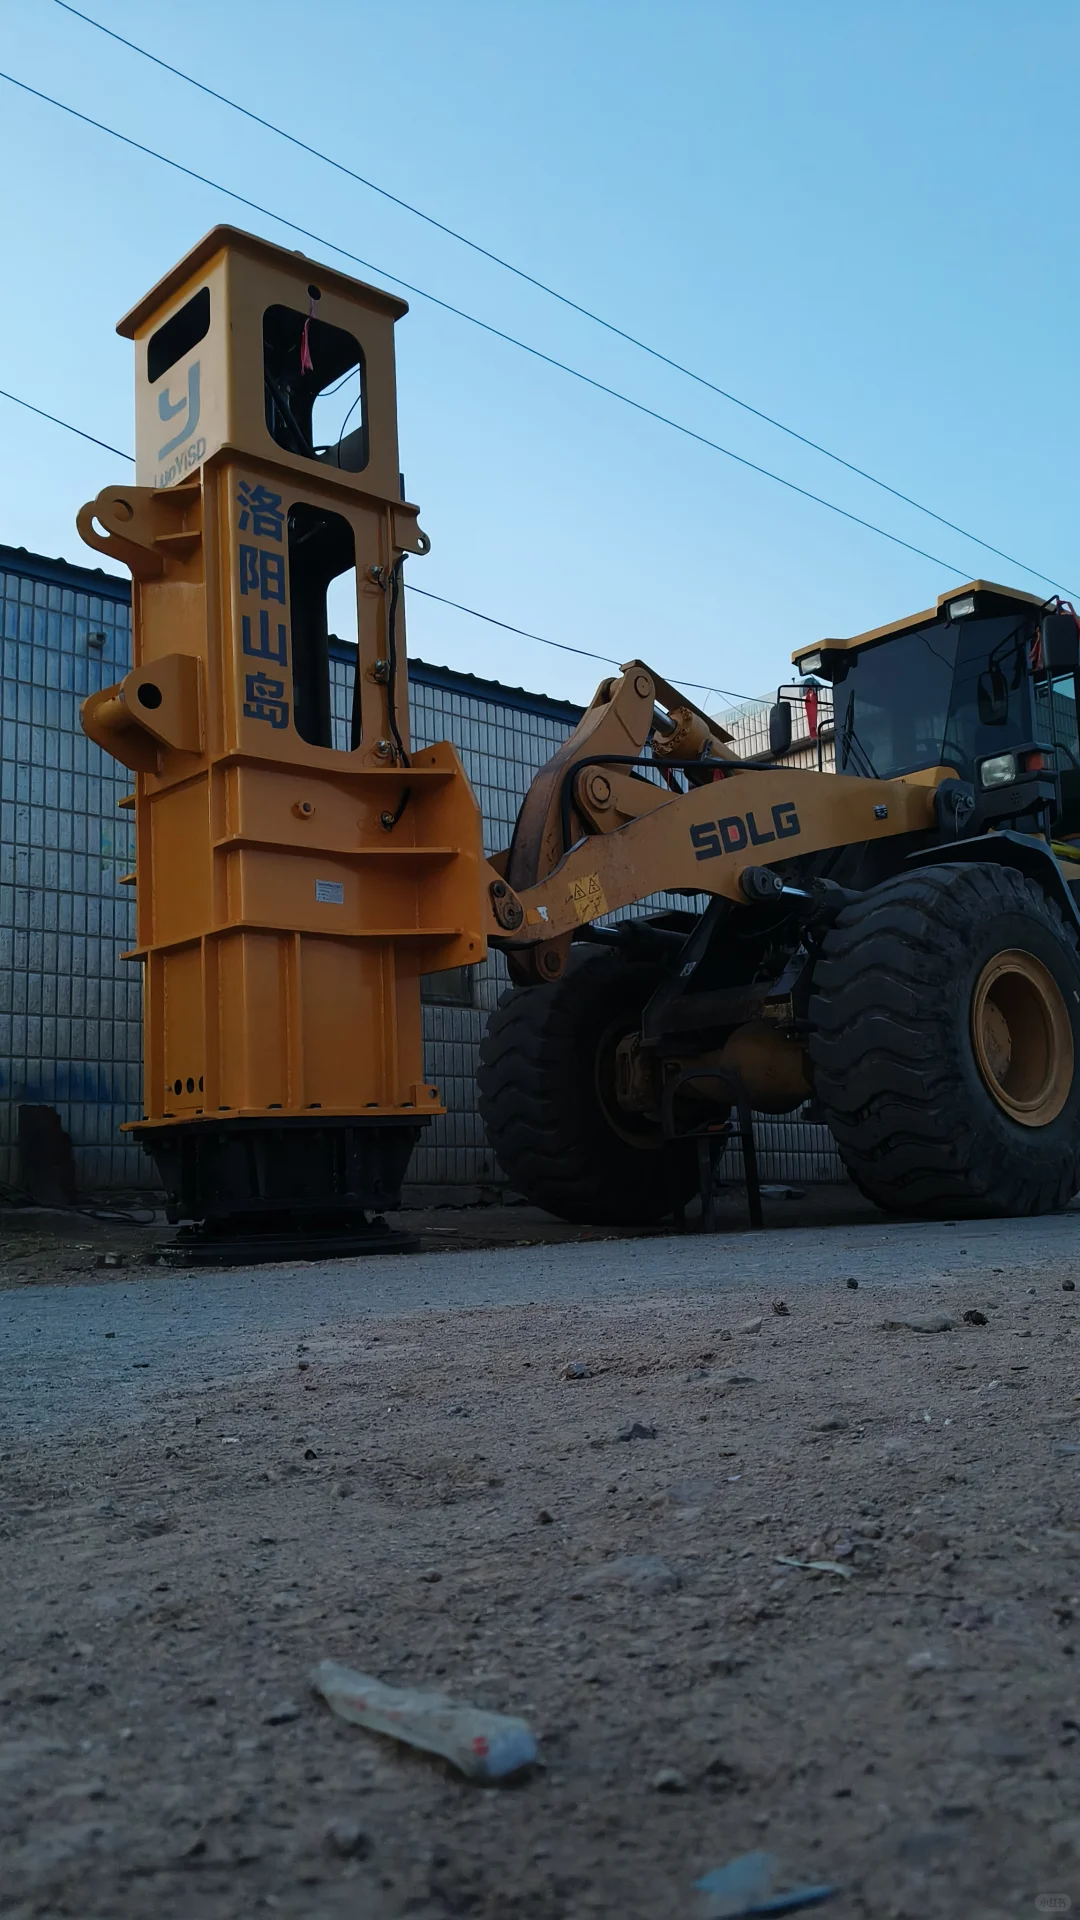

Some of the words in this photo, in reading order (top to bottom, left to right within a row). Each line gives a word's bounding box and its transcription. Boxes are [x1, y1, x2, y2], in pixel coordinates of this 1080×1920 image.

[237, 480, 288, 729] 洛阳山岛
[689, 802, 800, 861] SDLG
